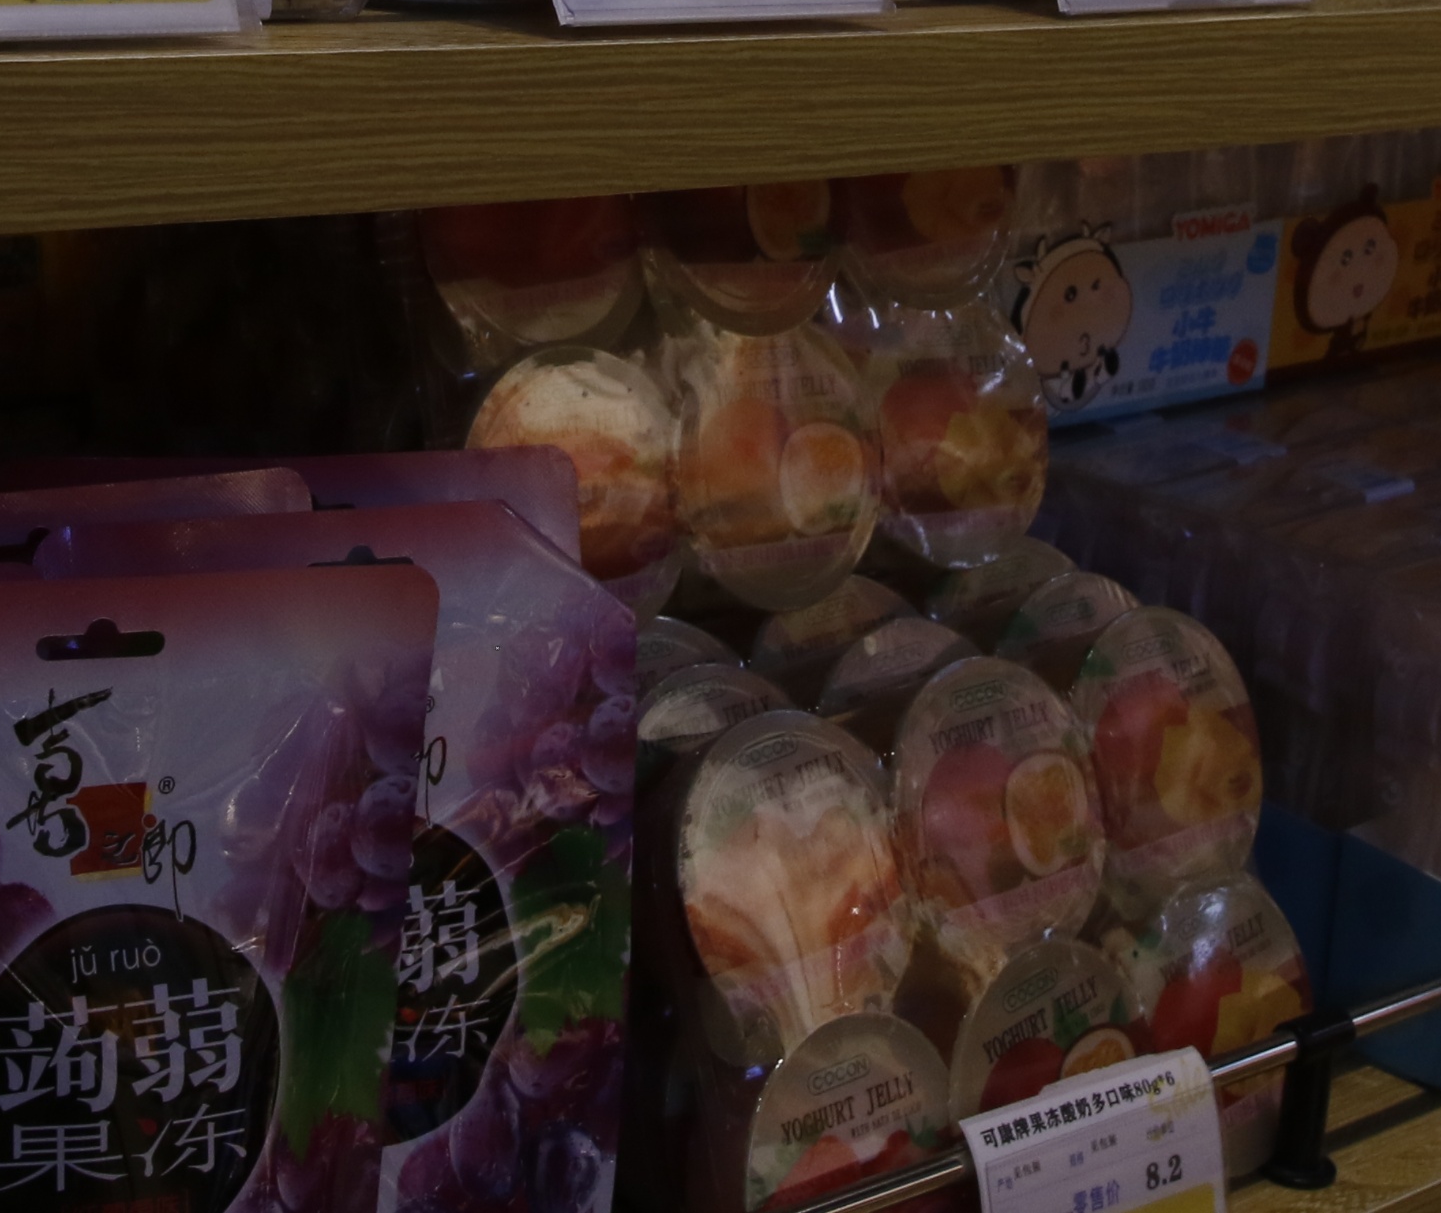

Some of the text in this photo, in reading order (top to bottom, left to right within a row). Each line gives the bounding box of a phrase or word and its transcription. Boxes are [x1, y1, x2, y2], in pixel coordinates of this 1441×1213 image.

[106, 939, 162, 971] ruò
[982, 974, 1099, 1064] YOGHURT JELLY
[811, 1058, 869, 1091] COCON
[781, 1071, 914, 1146] YOGHURT JELLY
[1145, 1154, 1183, 1190] 8.2
